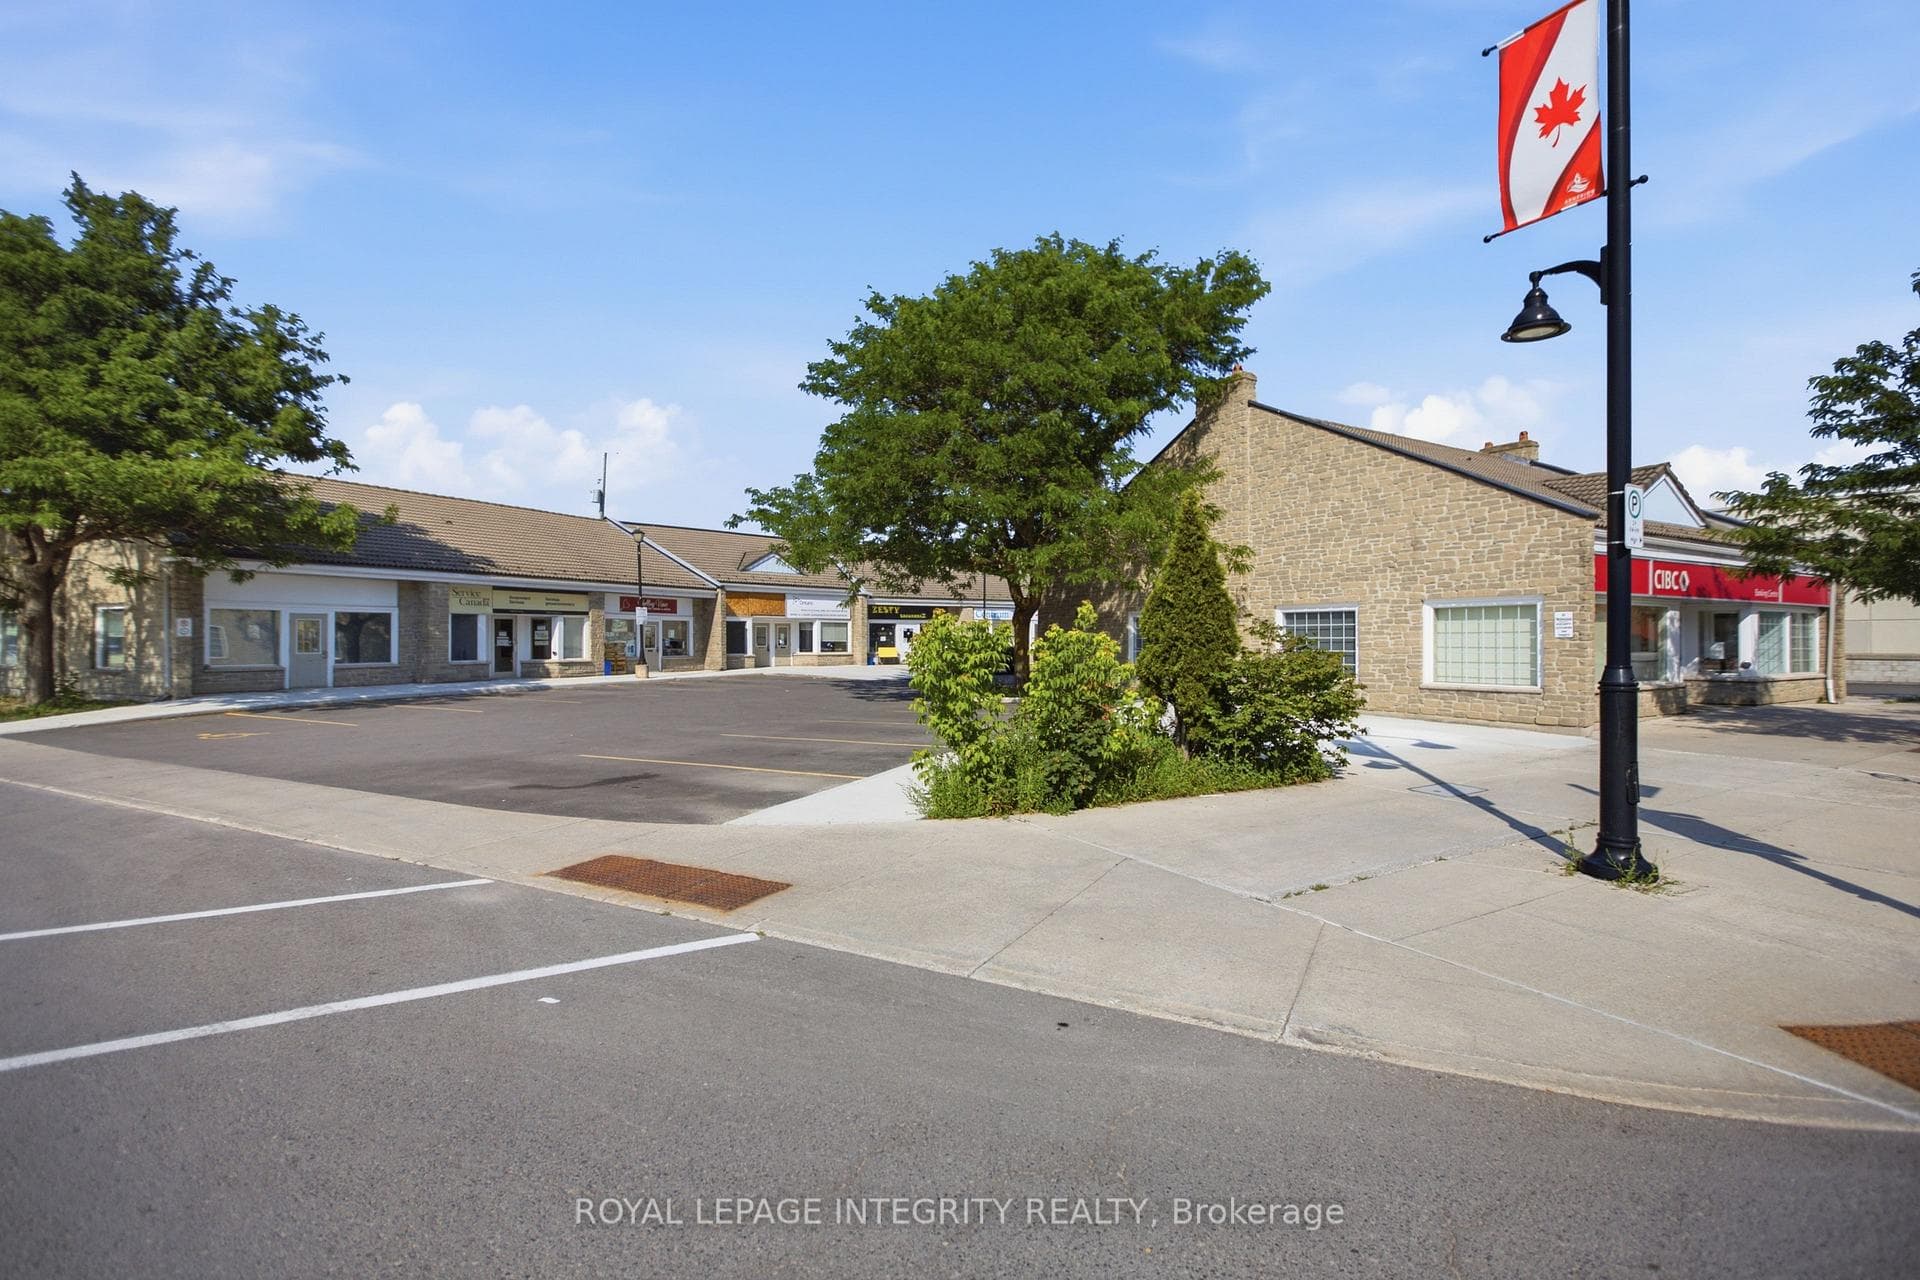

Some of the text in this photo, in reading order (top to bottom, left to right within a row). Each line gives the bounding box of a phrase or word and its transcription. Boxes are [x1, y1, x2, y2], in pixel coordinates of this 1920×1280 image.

[1632, 495, 1638, 511] P
[1655, 569, 1680, 590] CIBC
[451, 588, 480, 597] Service
[459, 597, 489, 608] Canada
[872, 606, 899, 614] ZESTY
